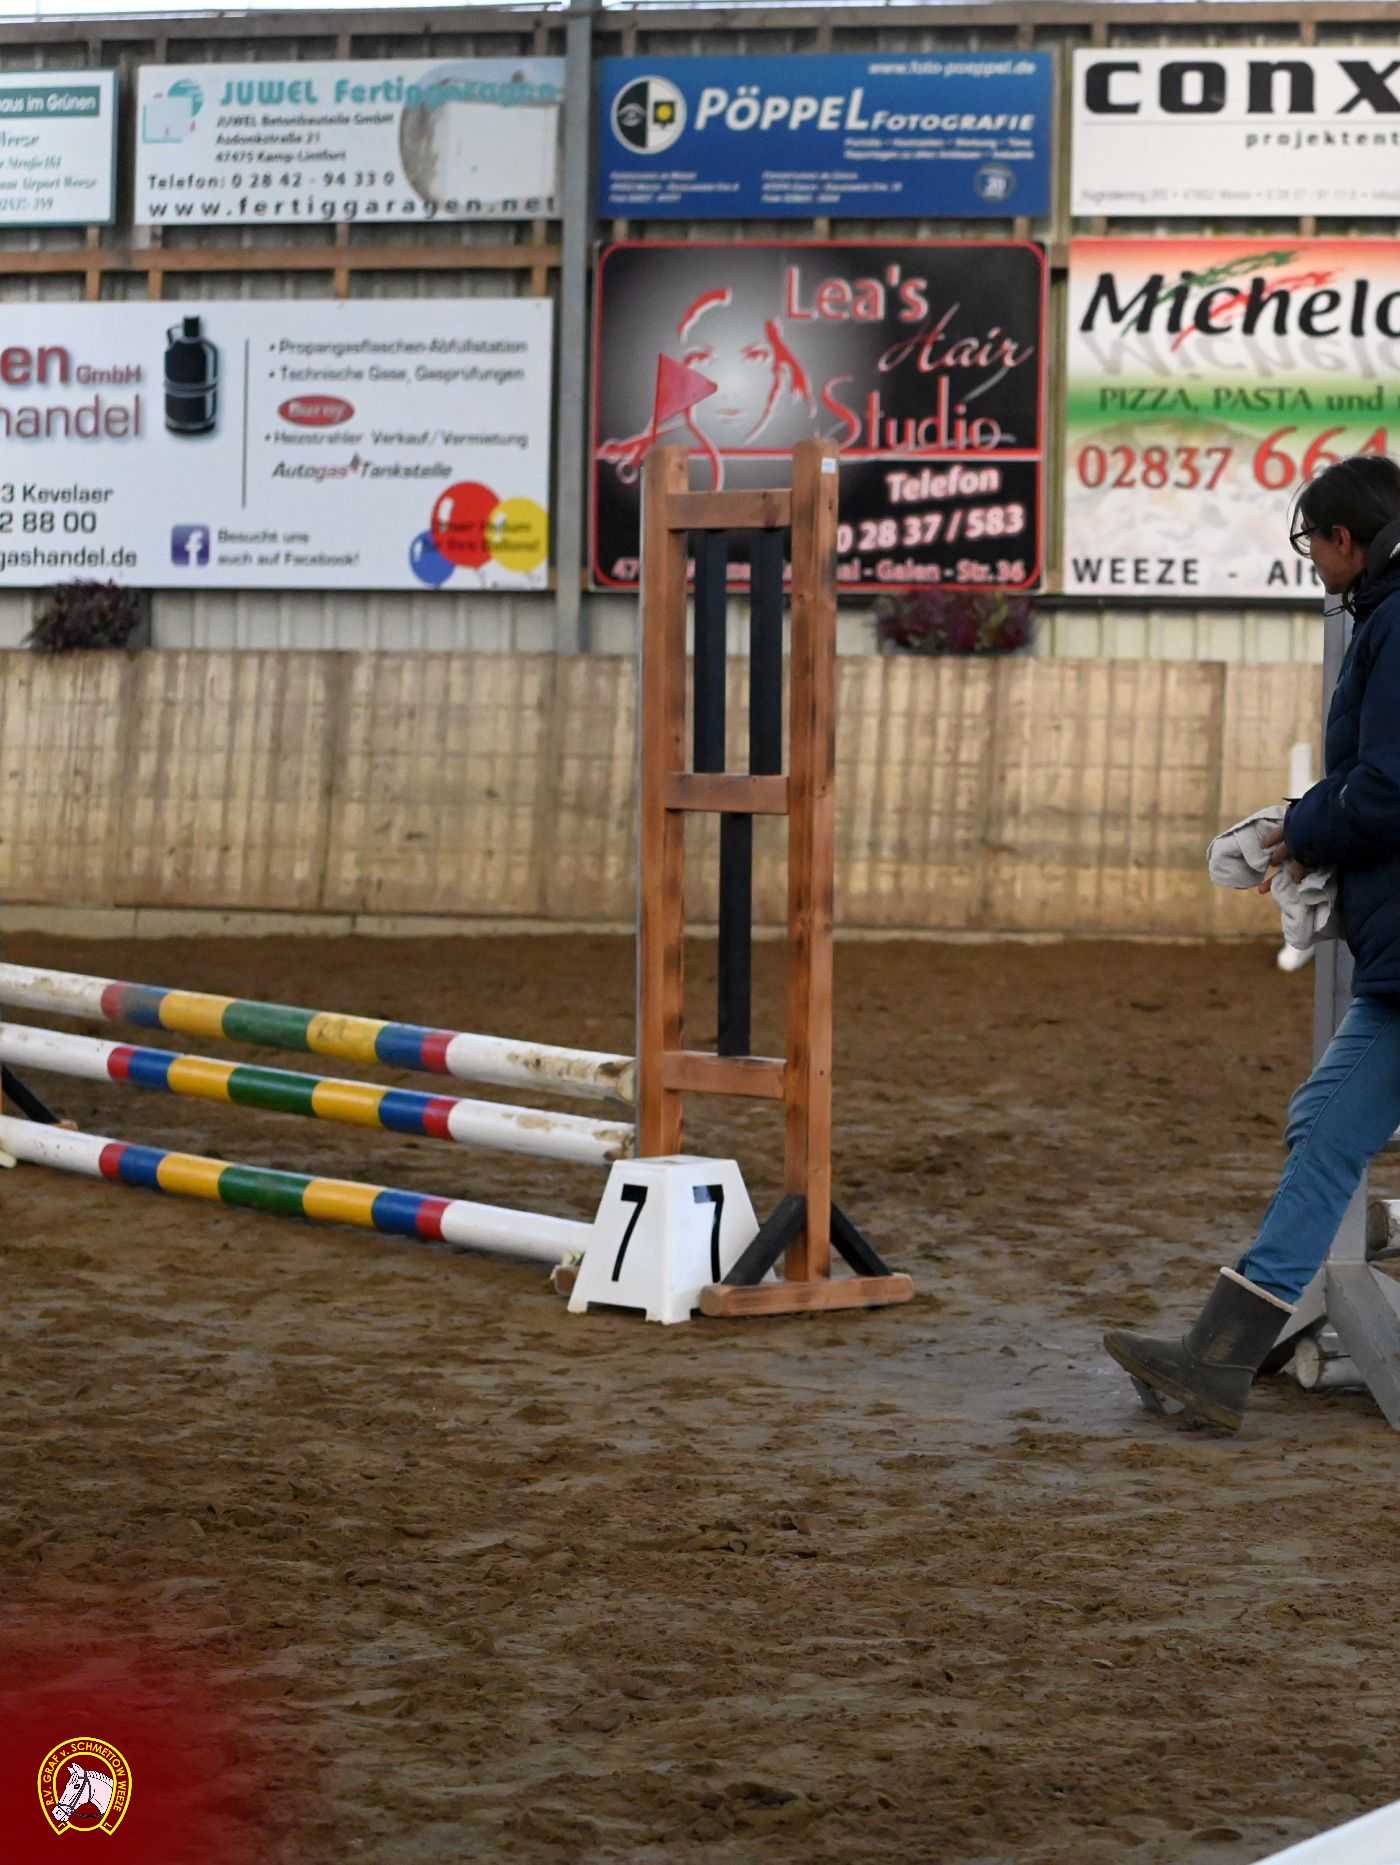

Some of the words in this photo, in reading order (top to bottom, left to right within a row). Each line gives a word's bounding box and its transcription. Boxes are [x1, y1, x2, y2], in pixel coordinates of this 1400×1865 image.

[220, 79, 318, 106] JUWEL
[694, 85, 869, 131] PÖPPEL
[871, 110, 1035, 131] FOTOGRAFIE
[149, 174, 225, 189] Telefon:
[231, 173, 242, 188] 0
[250, 173, 272, 188] 28
[280, 173, 302, 188] 42
[324, 172, 346, 186] 94
[355, 172, 377, 186] 33
[383, 172, 395, 186] 0
[149, 196, 556, 218] www.fertiggaragen.net
[786, 264, 929, 322] Lea's
[877, 302, 1034, 373] Hair
[0, 346, 70, 385] en
[76, 365, 142, 385] GmbH
[821, 374, 1004, 451] Studio
[1099, 387, 1199, 412] PIZZA,
[1212, 387, 1313, 411] PASTA
[1327, 385, 1384, 411] und
[886, 465, 1001, 503] Telefon
[1077, 445, 1233, 490] 02837
[23, 483, 114, 504] Kevelaer
[22, 511, 55, 534] 88
[63, 511, 97, 534] 00
[858, 518, 897, 551] 28
[902, 512, 943, 546] 37
[965, 503, 1025, 539] 583
[1071, 558, 1199, 586] WEEZE
[612, 1184, 648, 1282] 7
[692, 1184, 725, 1283] 7
